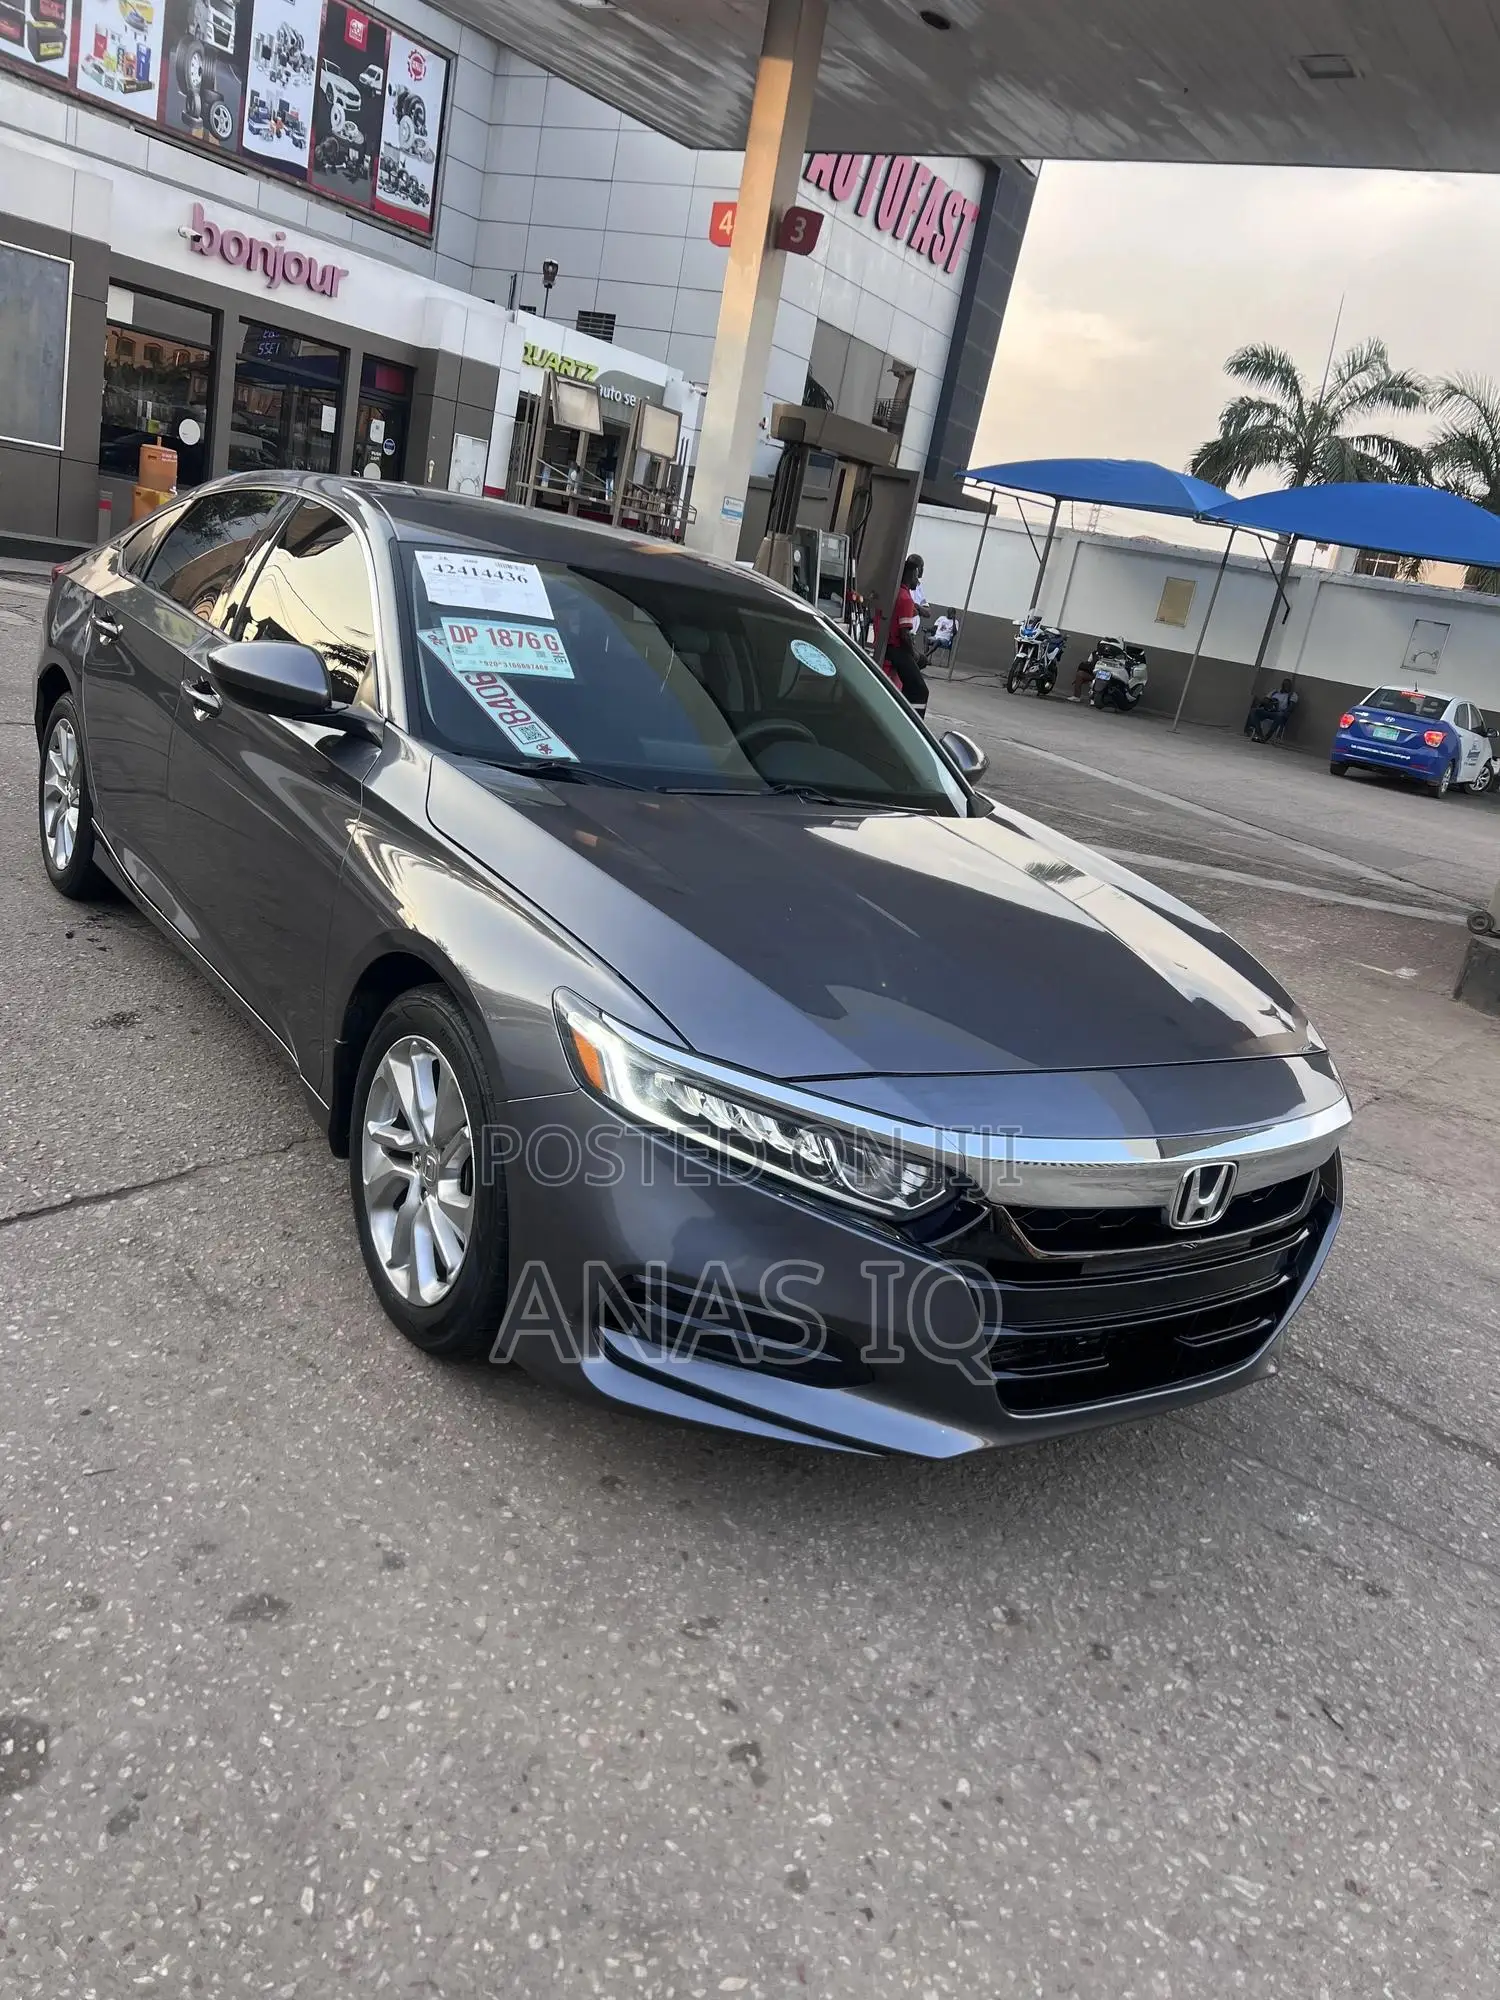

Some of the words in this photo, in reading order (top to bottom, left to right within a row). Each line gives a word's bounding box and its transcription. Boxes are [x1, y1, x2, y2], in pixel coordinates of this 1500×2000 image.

[718, 210, 734, 236] 4
[790, 216, 807, 243] 3
[191, 202, 349, 298] bonjour
[433, 563, 528, 583] 42414436
[448, 624, 478, 644] DP
[485, 627, 541, 650] 1876
[544, 633, 560, 651] G
